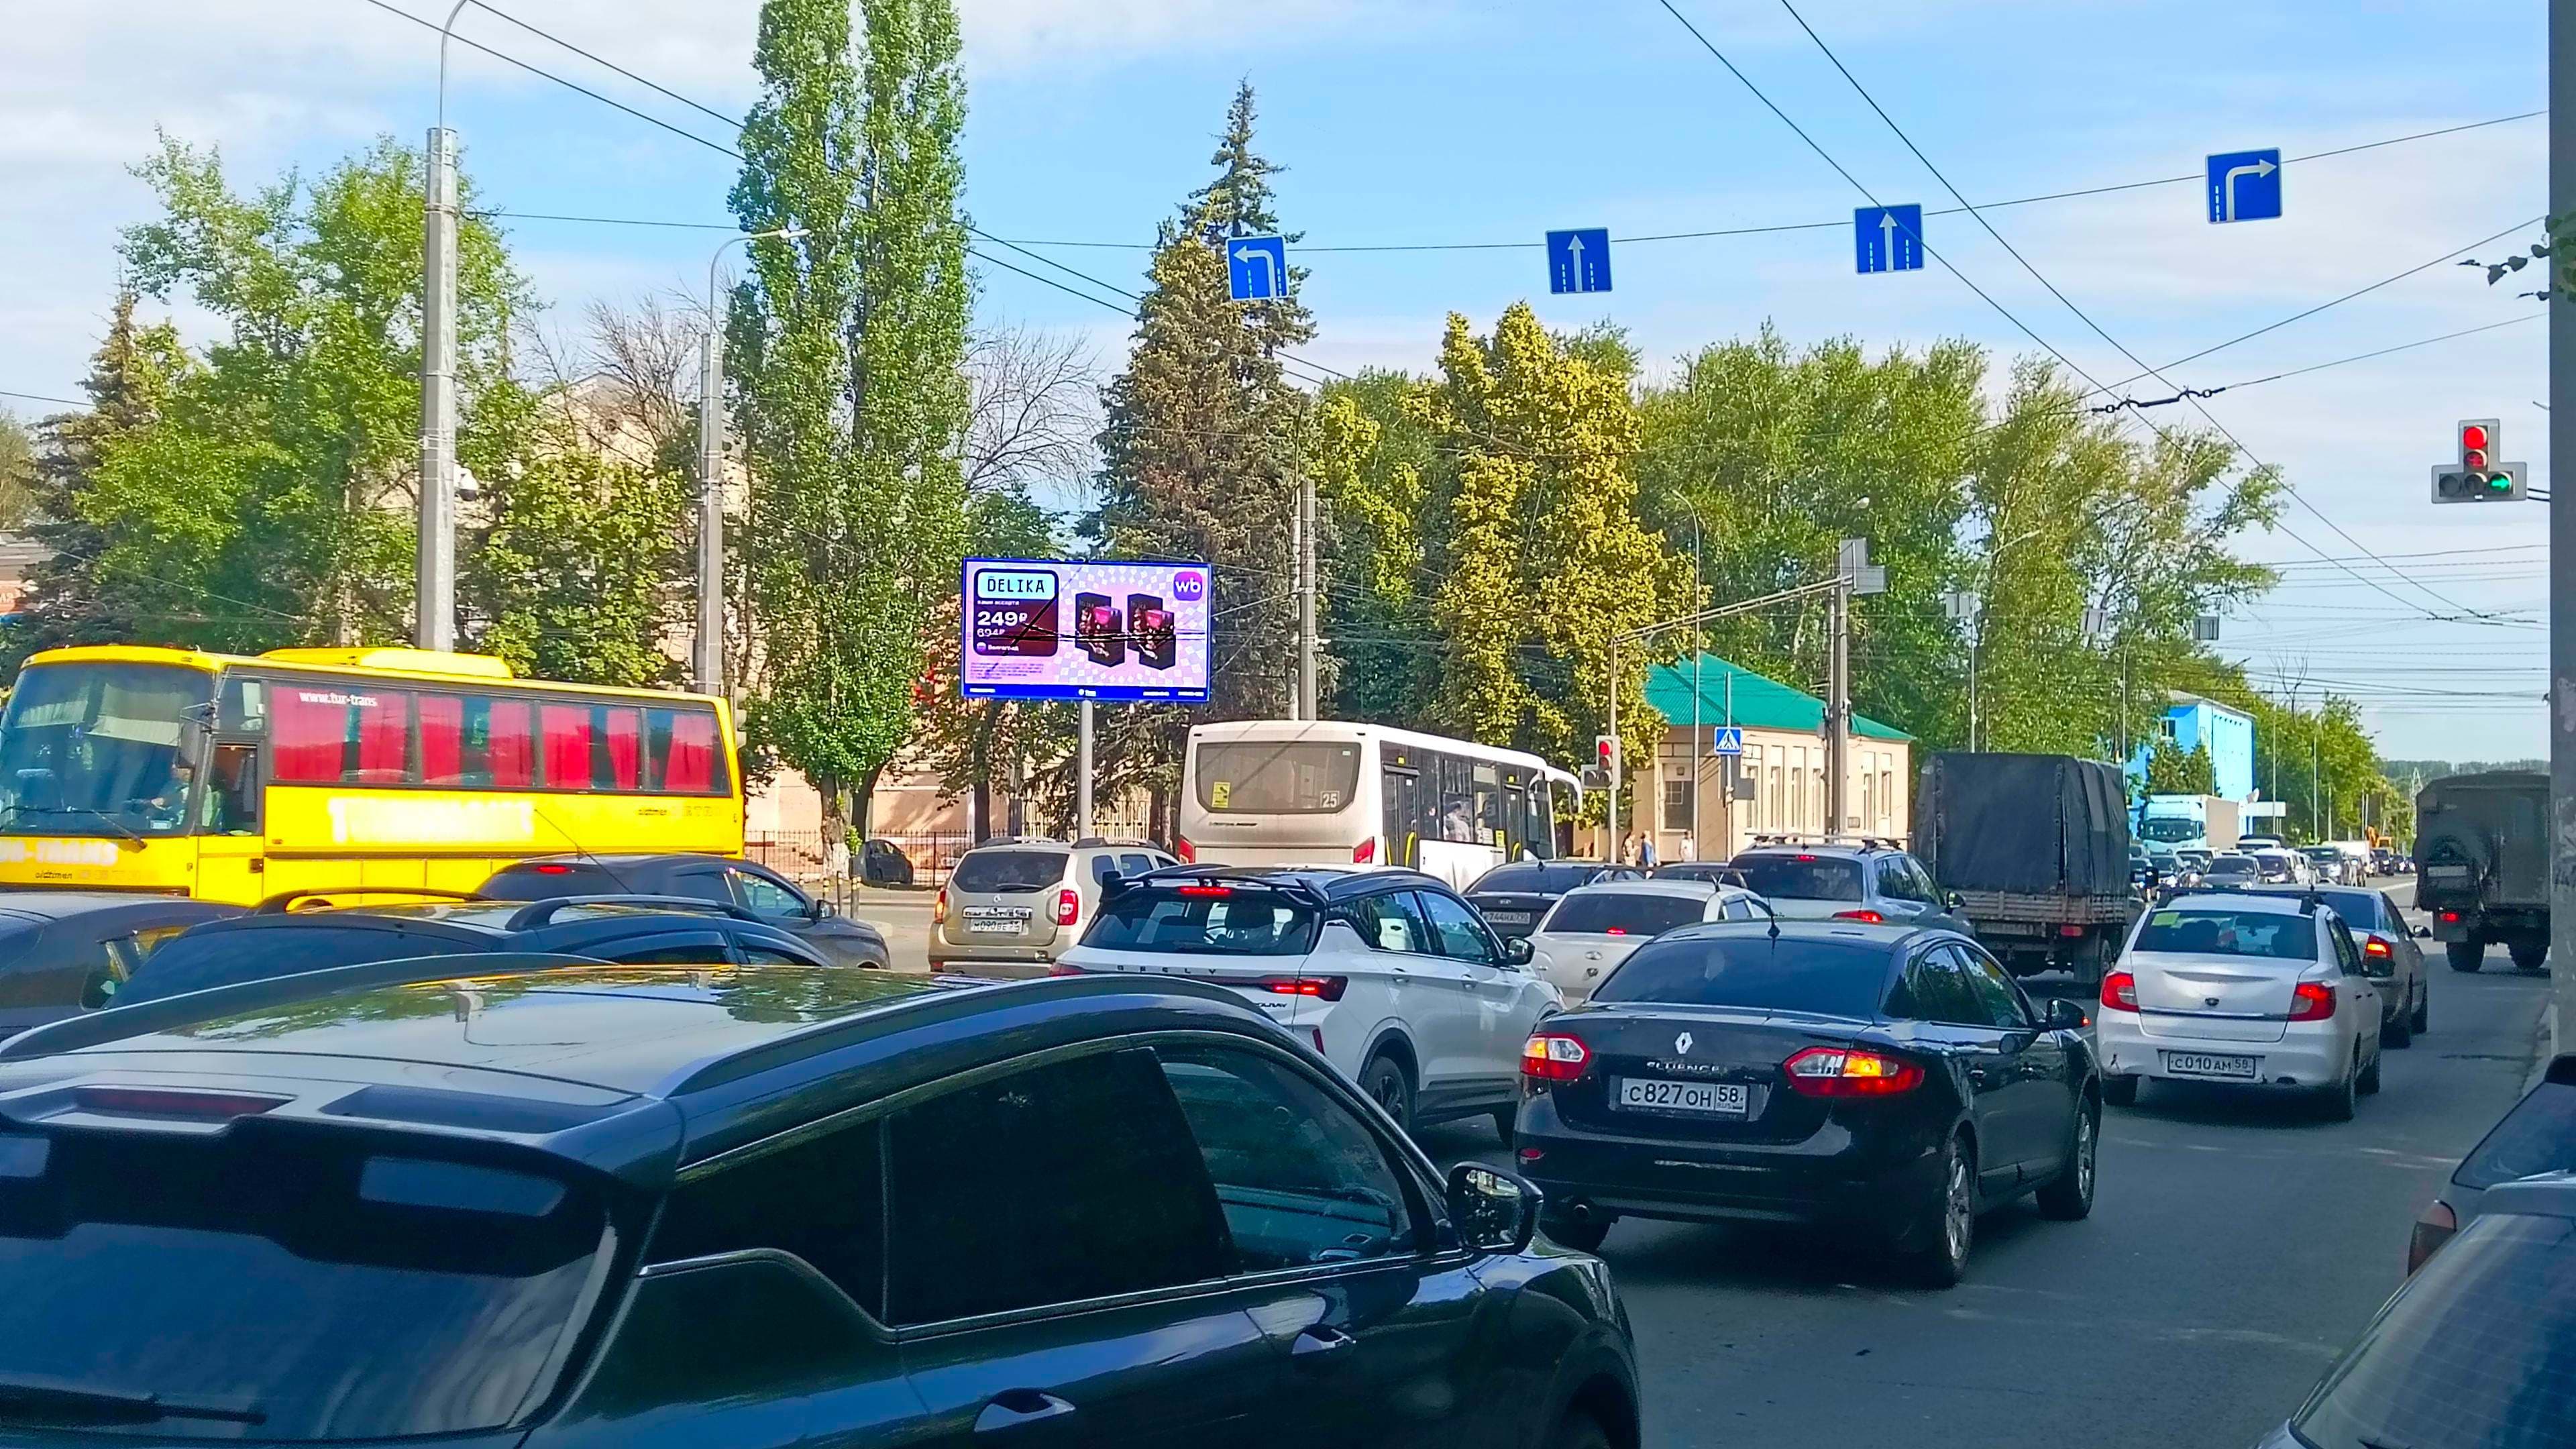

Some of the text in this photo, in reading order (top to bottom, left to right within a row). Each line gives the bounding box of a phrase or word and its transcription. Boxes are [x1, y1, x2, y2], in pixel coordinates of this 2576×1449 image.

[987, 577, 1044, 593] DELIKA
[1175, 578, 1201, 593] wb
[1322, 793, 1338, 808] 25
